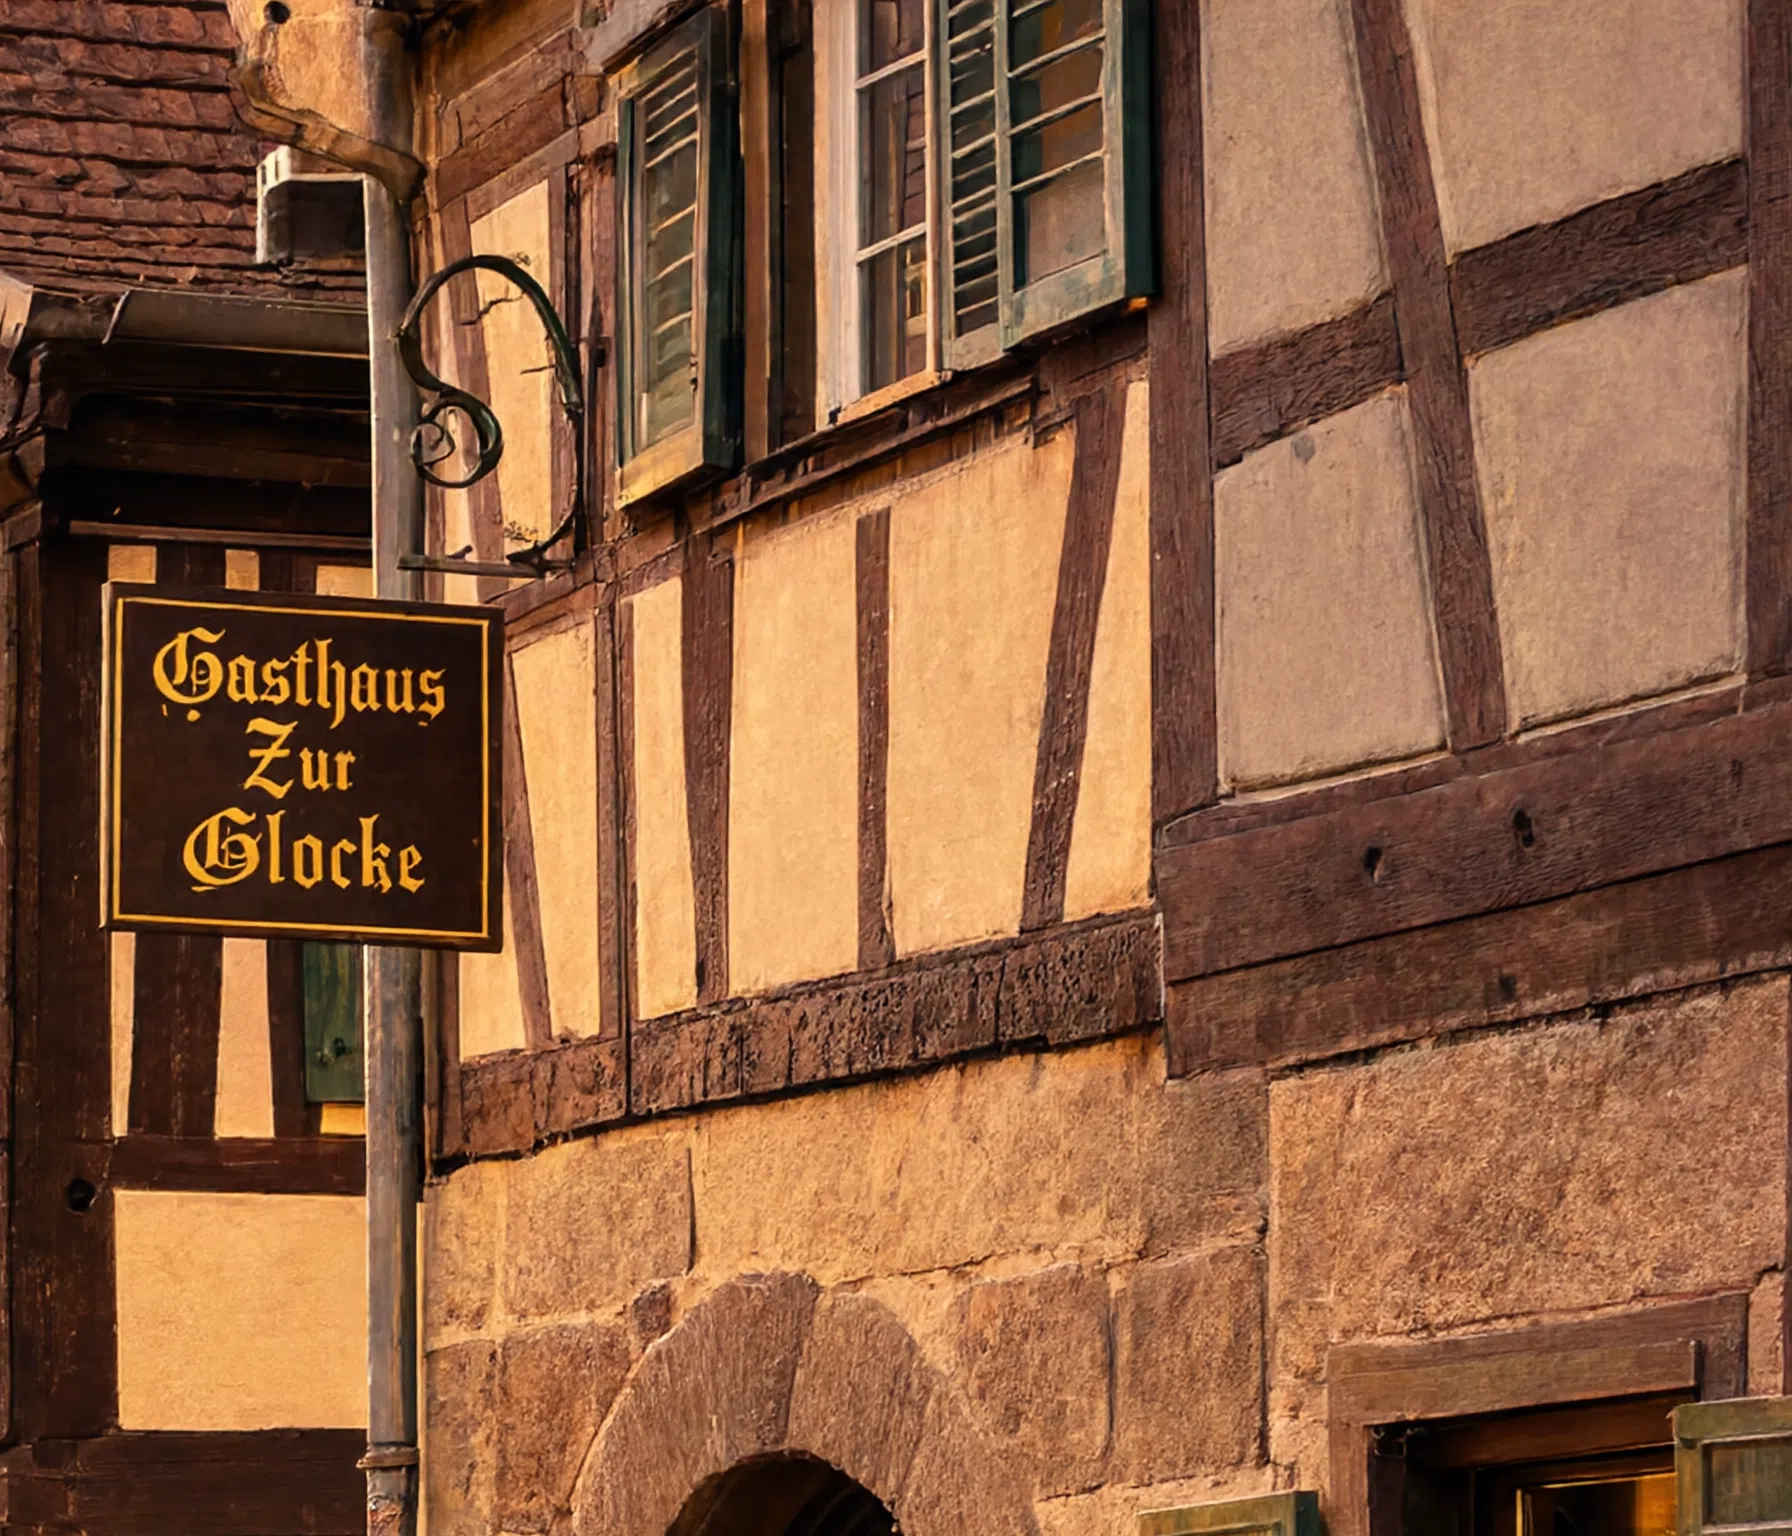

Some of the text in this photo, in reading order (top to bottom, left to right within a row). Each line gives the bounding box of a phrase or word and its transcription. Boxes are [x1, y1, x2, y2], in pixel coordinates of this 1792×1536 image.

[153, 626, 446, 728] Gasthaus
[243, 717, 356, 799] Zur
[182, 807, 425, 893] Glocke
